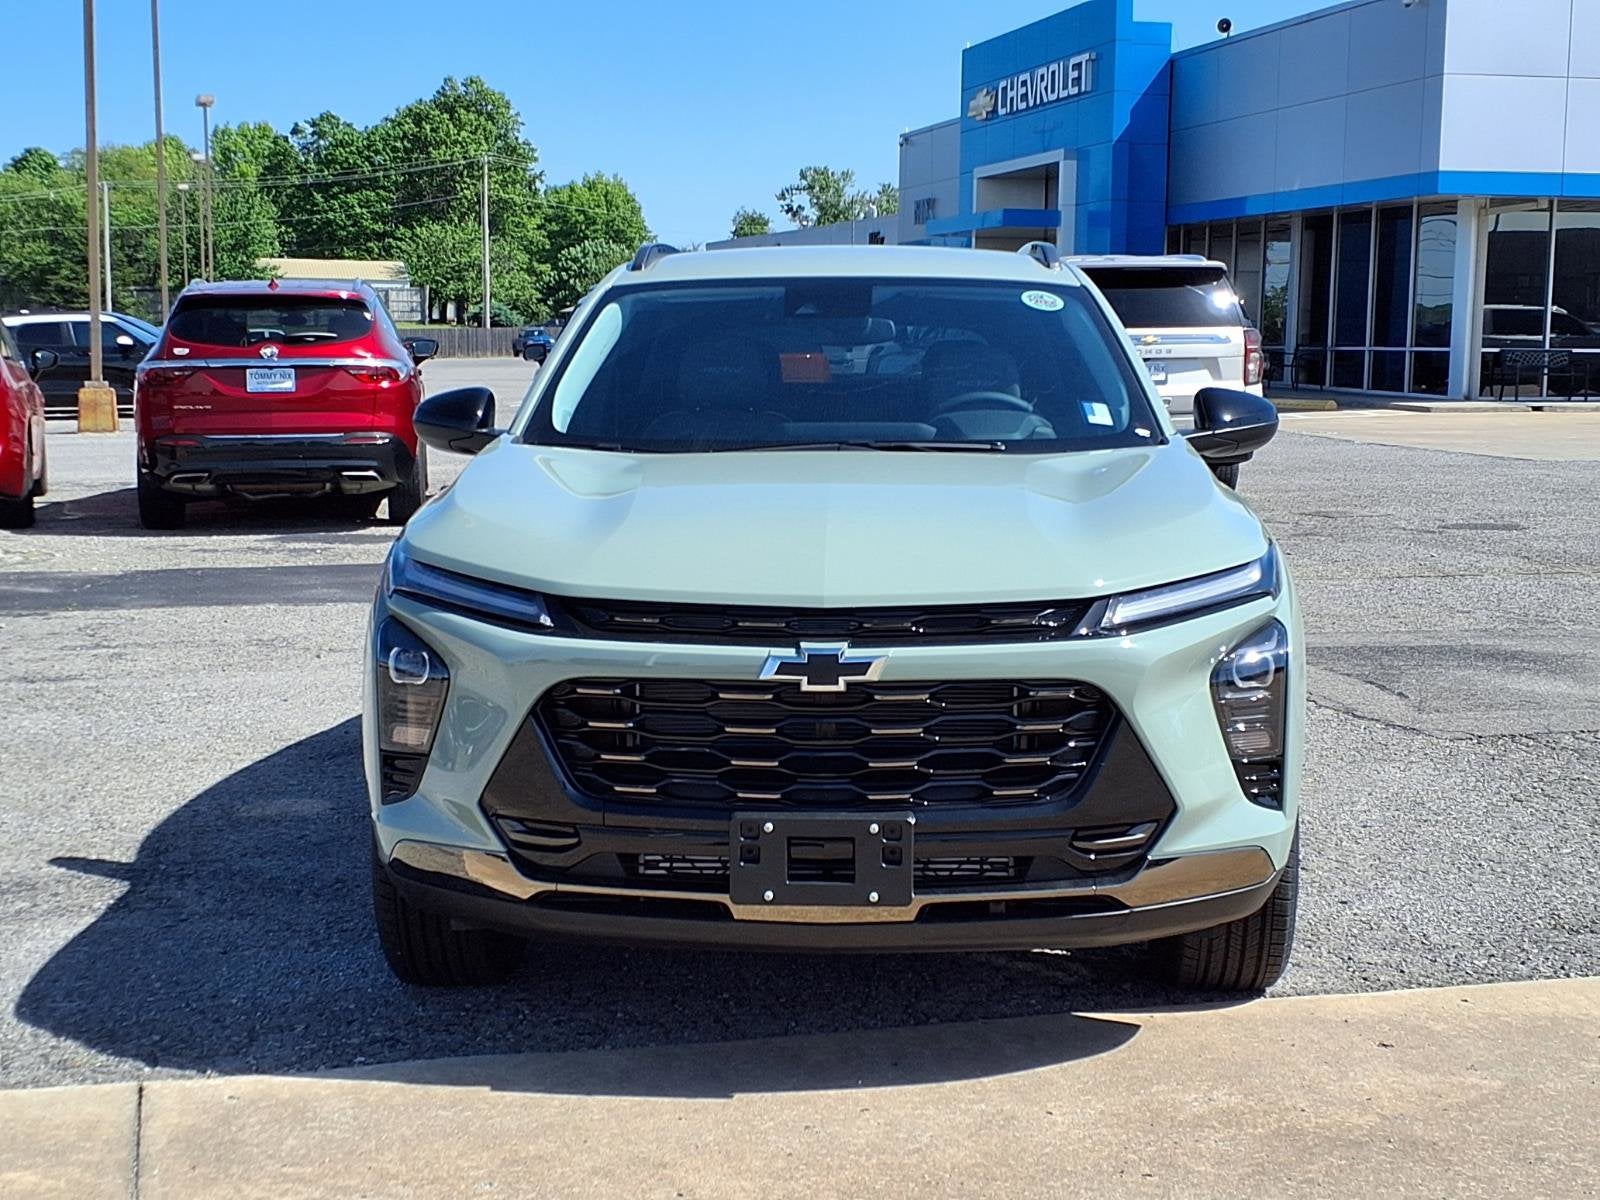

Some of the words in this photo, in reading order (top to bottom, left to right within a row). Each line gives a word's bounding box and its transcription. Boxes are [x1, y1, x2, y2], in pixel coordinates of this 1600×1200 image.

[998, 53, 1091, 115] CHEVROLET
[250, 371, 278, 380] TOMMY
[280, 371, 292, 380] NIX
